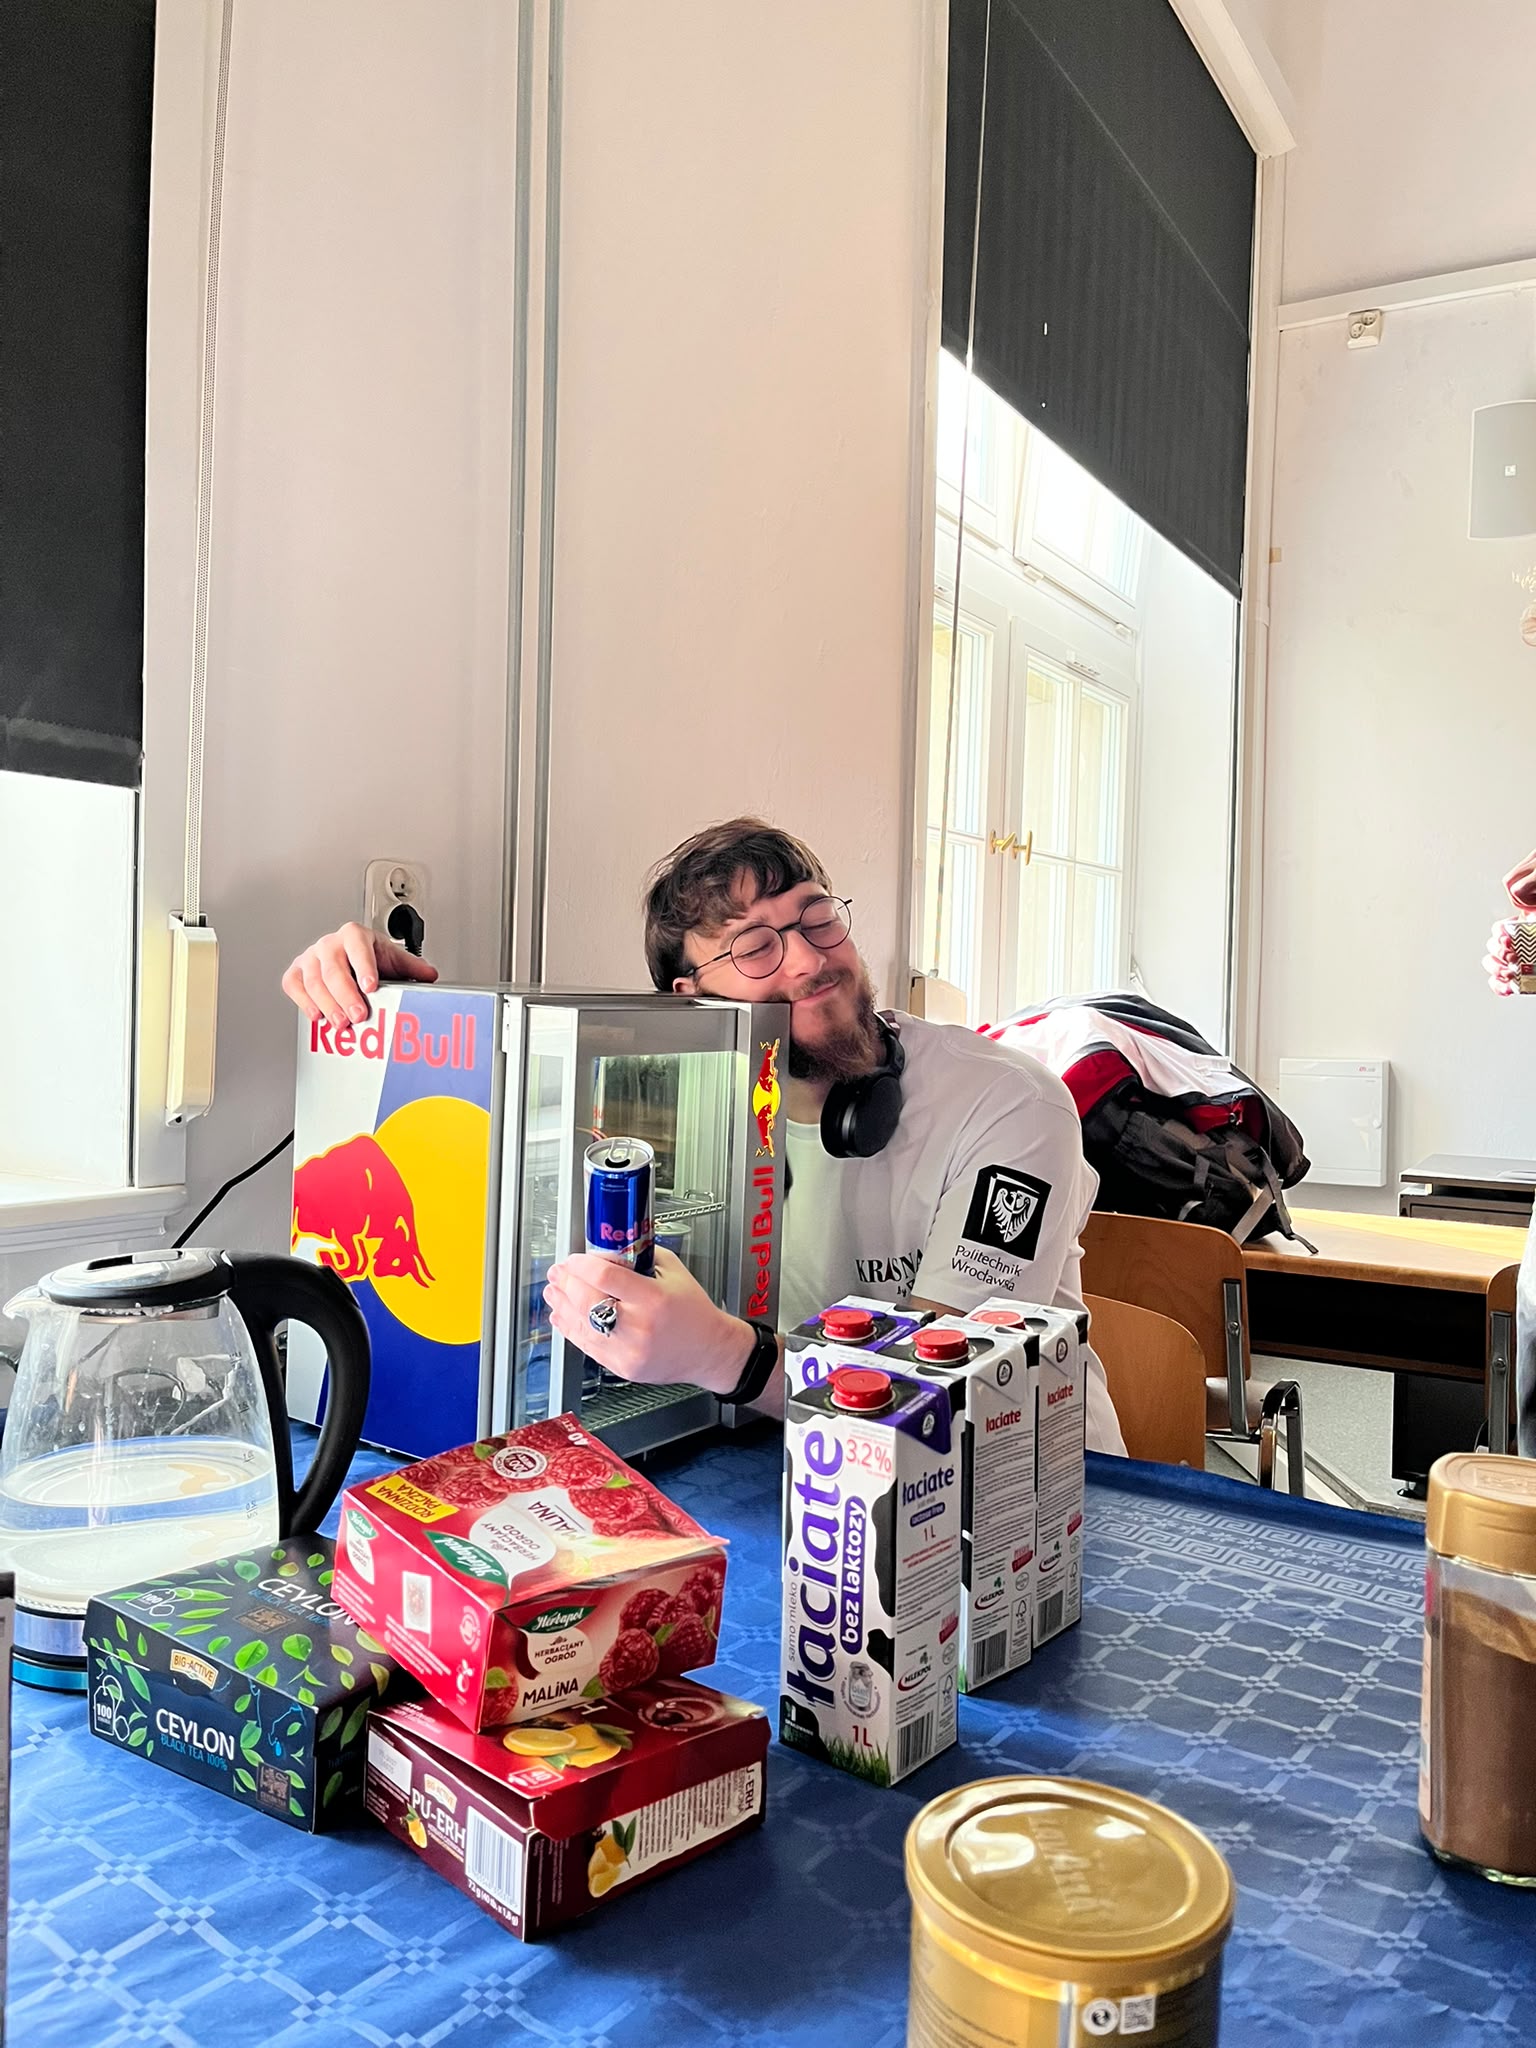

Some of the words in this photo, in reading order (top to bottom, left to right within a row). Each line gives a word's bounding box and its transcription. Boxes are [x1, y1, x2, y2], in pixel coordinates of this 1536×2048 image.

[310, 1008, 386, 1060] Red
[392, 1011, 477, 1071] Bull
[751, 1165, 775, 1238] Bull
[600, 1220, 639, 1242] Red
[746, 1241, 772, 1318] Red
[845, 1438, 893, 1473] 3,2%
[376, 1485, 436, 1518] RODZINNA
[397, 1482, 442, 1509] PACZKA
[434, 1537, 502, 1577] Herbapol
[843, 1501, 866, 1595] laktozy
[257, 1578, 357, 1627] CEYLON
[531, 1607, 585, 1631] Herbapol
[789, 1581, 798, 1624] mleko
[842, 1600, 860, 1643] bez
[788, 1625, 797, 1662] samo
[173, 1653, 215, 1683] BIG-ACTIVE
[96, 1702, 112, 1719] 100
[156, 1708, 236, 1761] CEYLON
[160, 1732, 187, 1755] BLACK
[187, 1743, 205, 1763] TEA
[206, 1753, 229, 1772] 100%
[412, 1787, 466, 1849] PU-ERH
